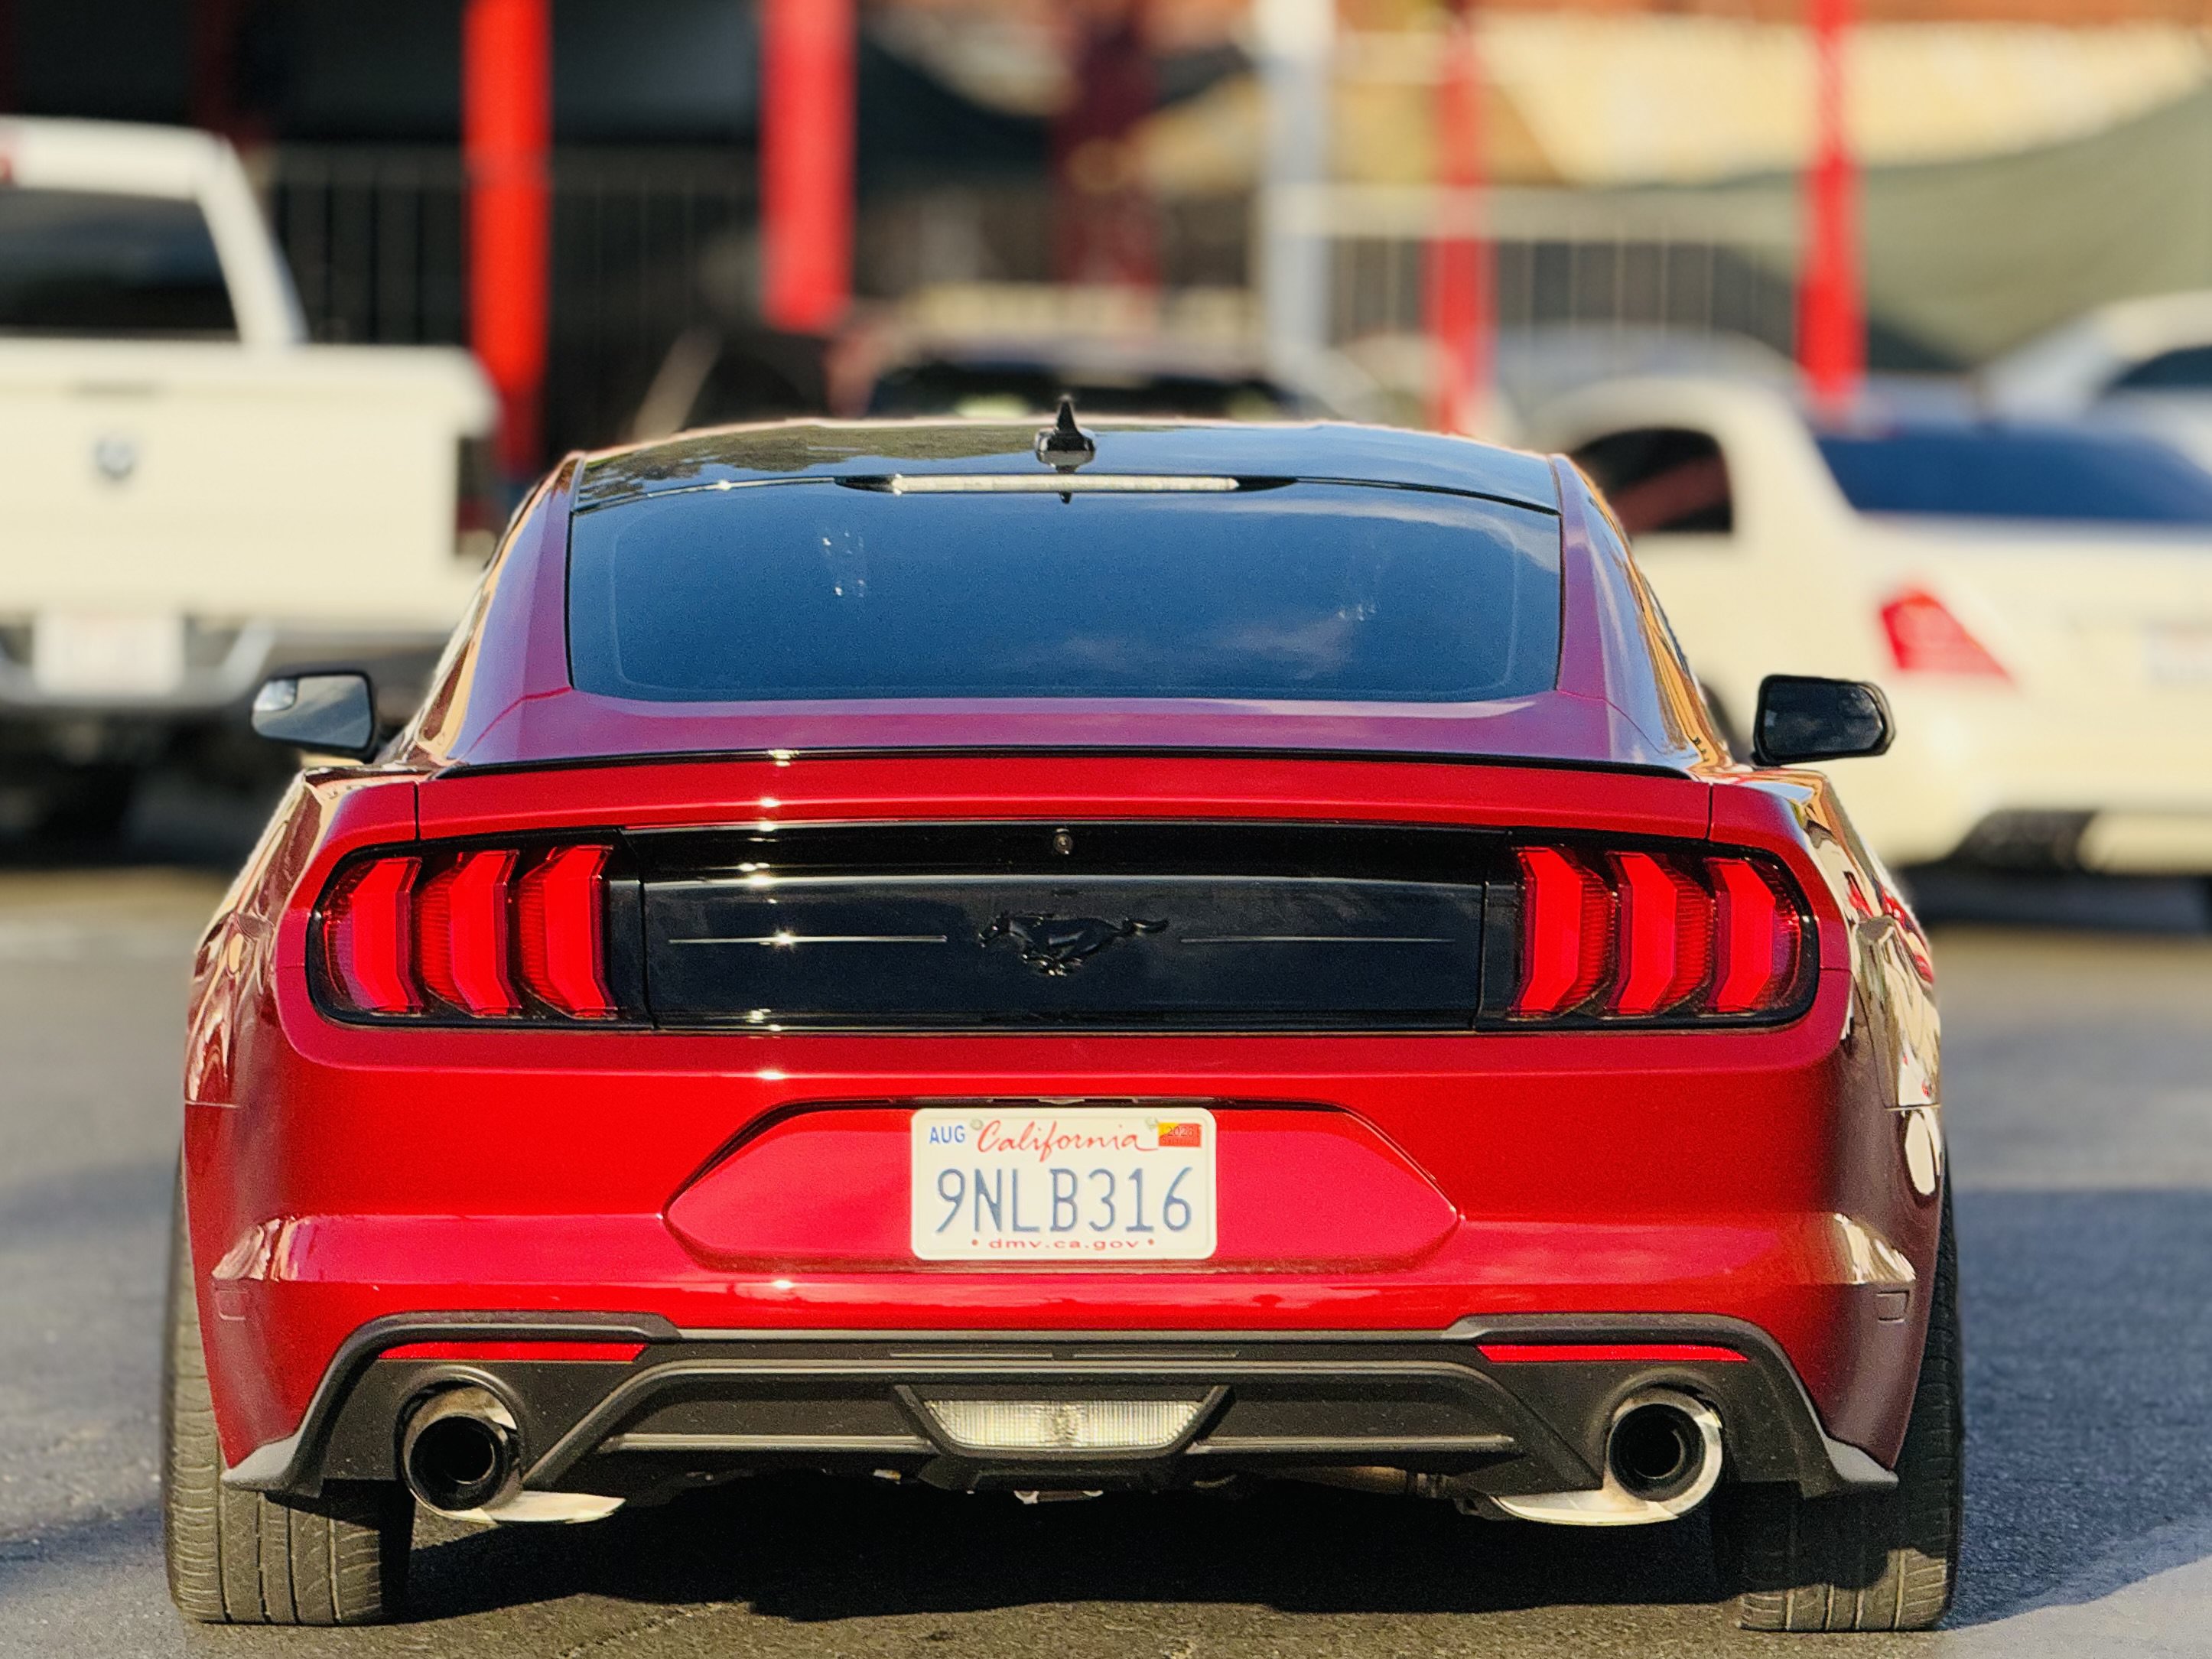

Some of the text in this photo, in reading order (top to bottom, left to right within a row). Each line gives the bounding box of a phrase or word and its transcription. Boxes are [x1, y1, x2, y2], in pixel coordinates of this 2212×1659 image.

[929, 1125, 966, 1144] AUG
[977, 1119, 1158, 1163] California
[935, 1167, 1192, 1233] 9NLB316
[988, 1238, 1140, 1251] dmv.ca.gov
